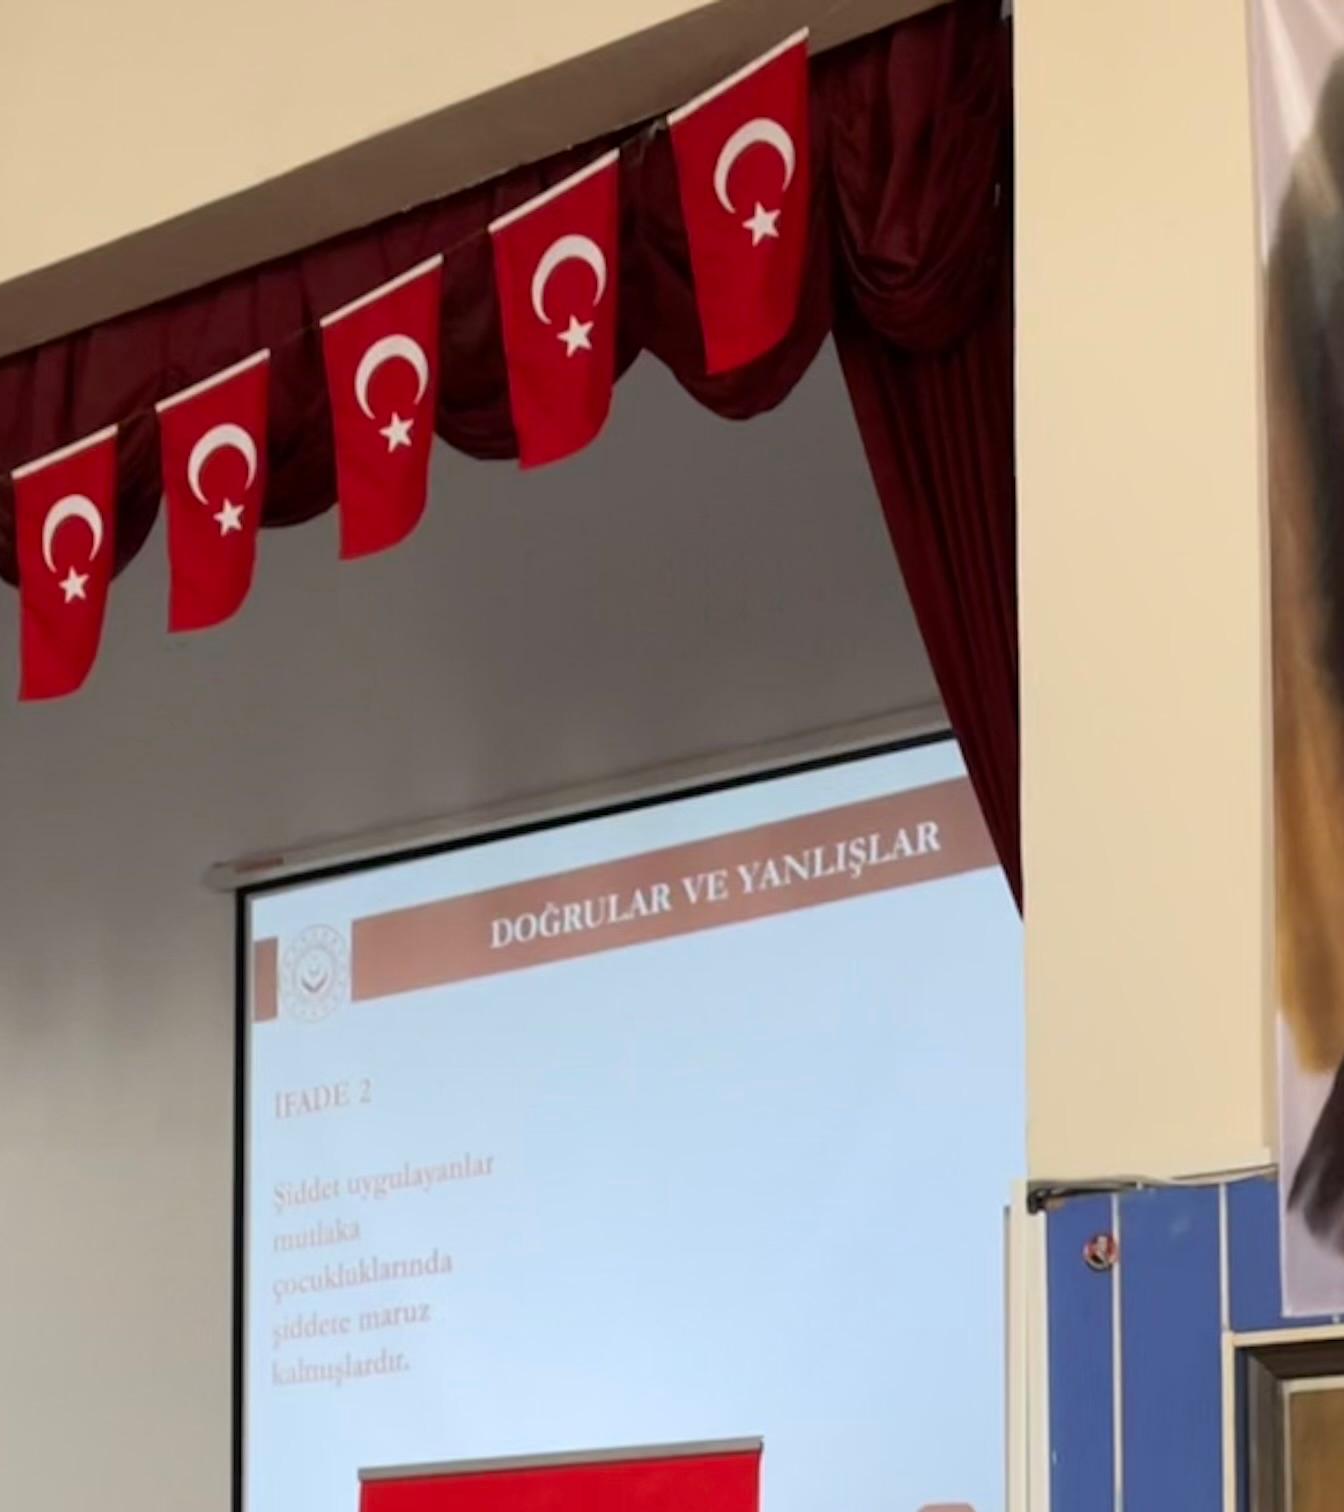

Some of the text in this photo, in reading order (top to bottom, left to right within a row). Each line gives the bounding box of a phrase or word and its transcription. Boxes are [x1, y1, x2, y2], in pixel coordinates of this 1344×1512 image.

[490, 820, 941, 949] DOĞRULAR VE YANLIŞLAR
[359, 1077, 372, 1103] 2
[272, 1151, 494, 1214] Şiddet uygulayanlar
[272, 1217, 360, 1253] mutlaka
[272, 1248, 453, 1304] çocukluklarında
[272, 1302, 431, 1350] şiddete maruz
